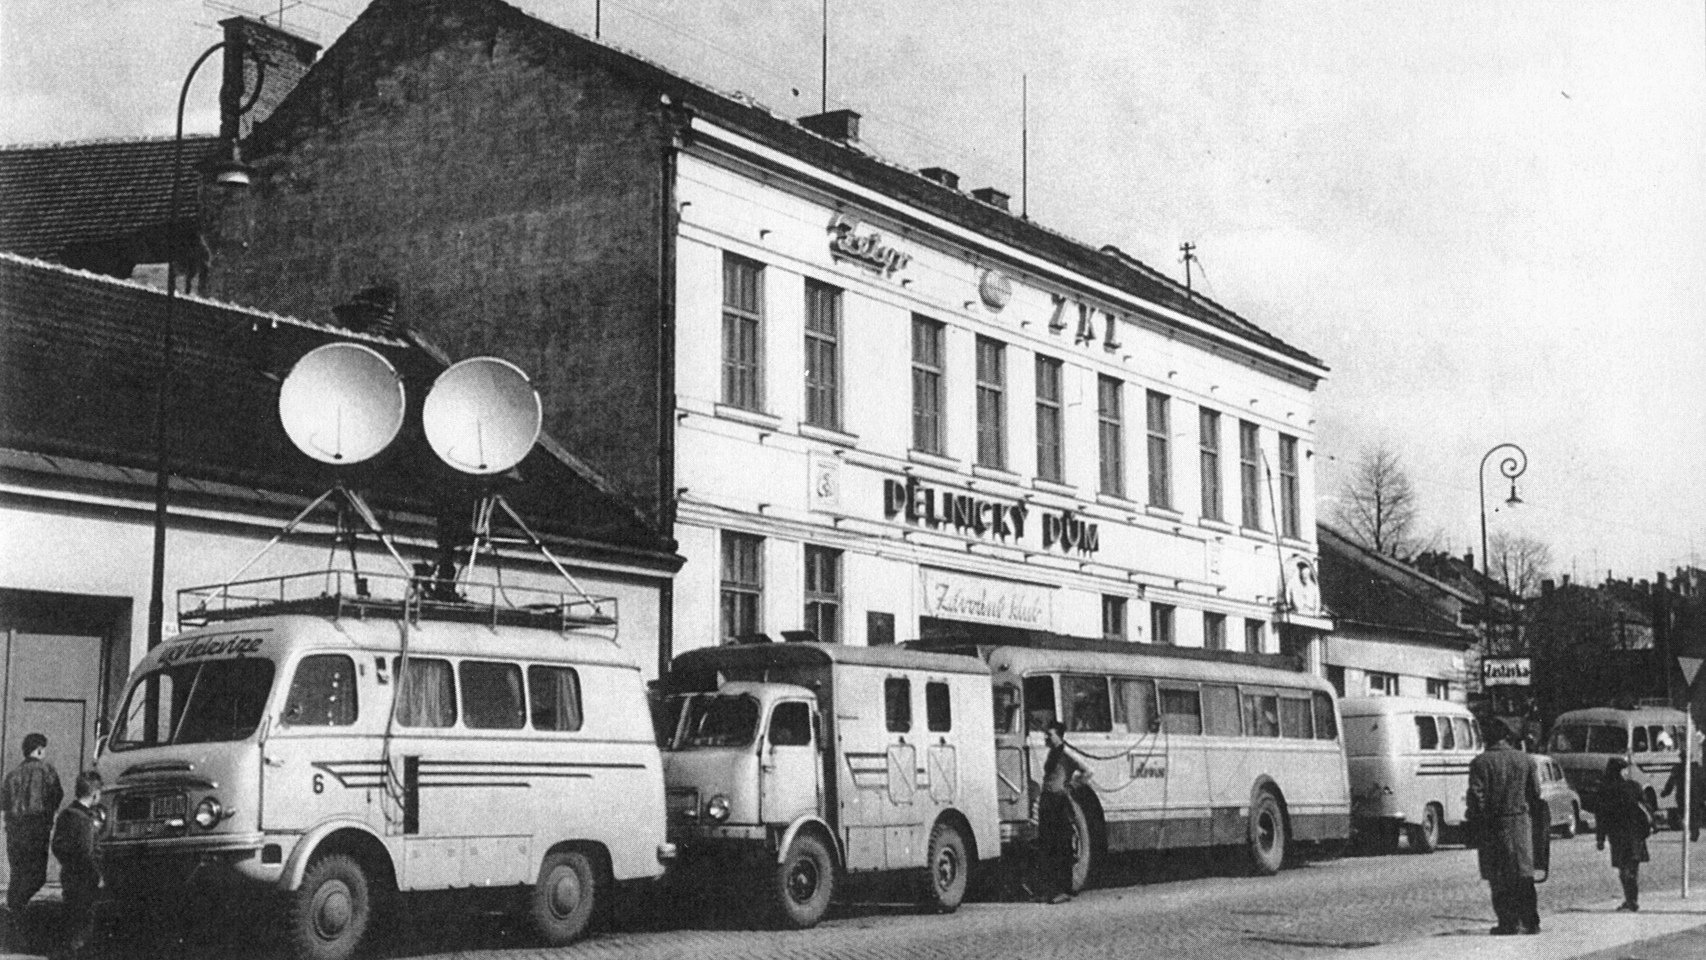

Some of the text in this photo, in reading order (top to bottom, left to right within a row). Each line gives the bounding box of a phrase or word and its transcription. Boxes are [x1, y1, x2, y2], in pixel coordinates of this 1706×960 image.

[884, 475, 1099, 555] DĚLNICKÝ DŮM
[313, 773, 324, 794] 6
